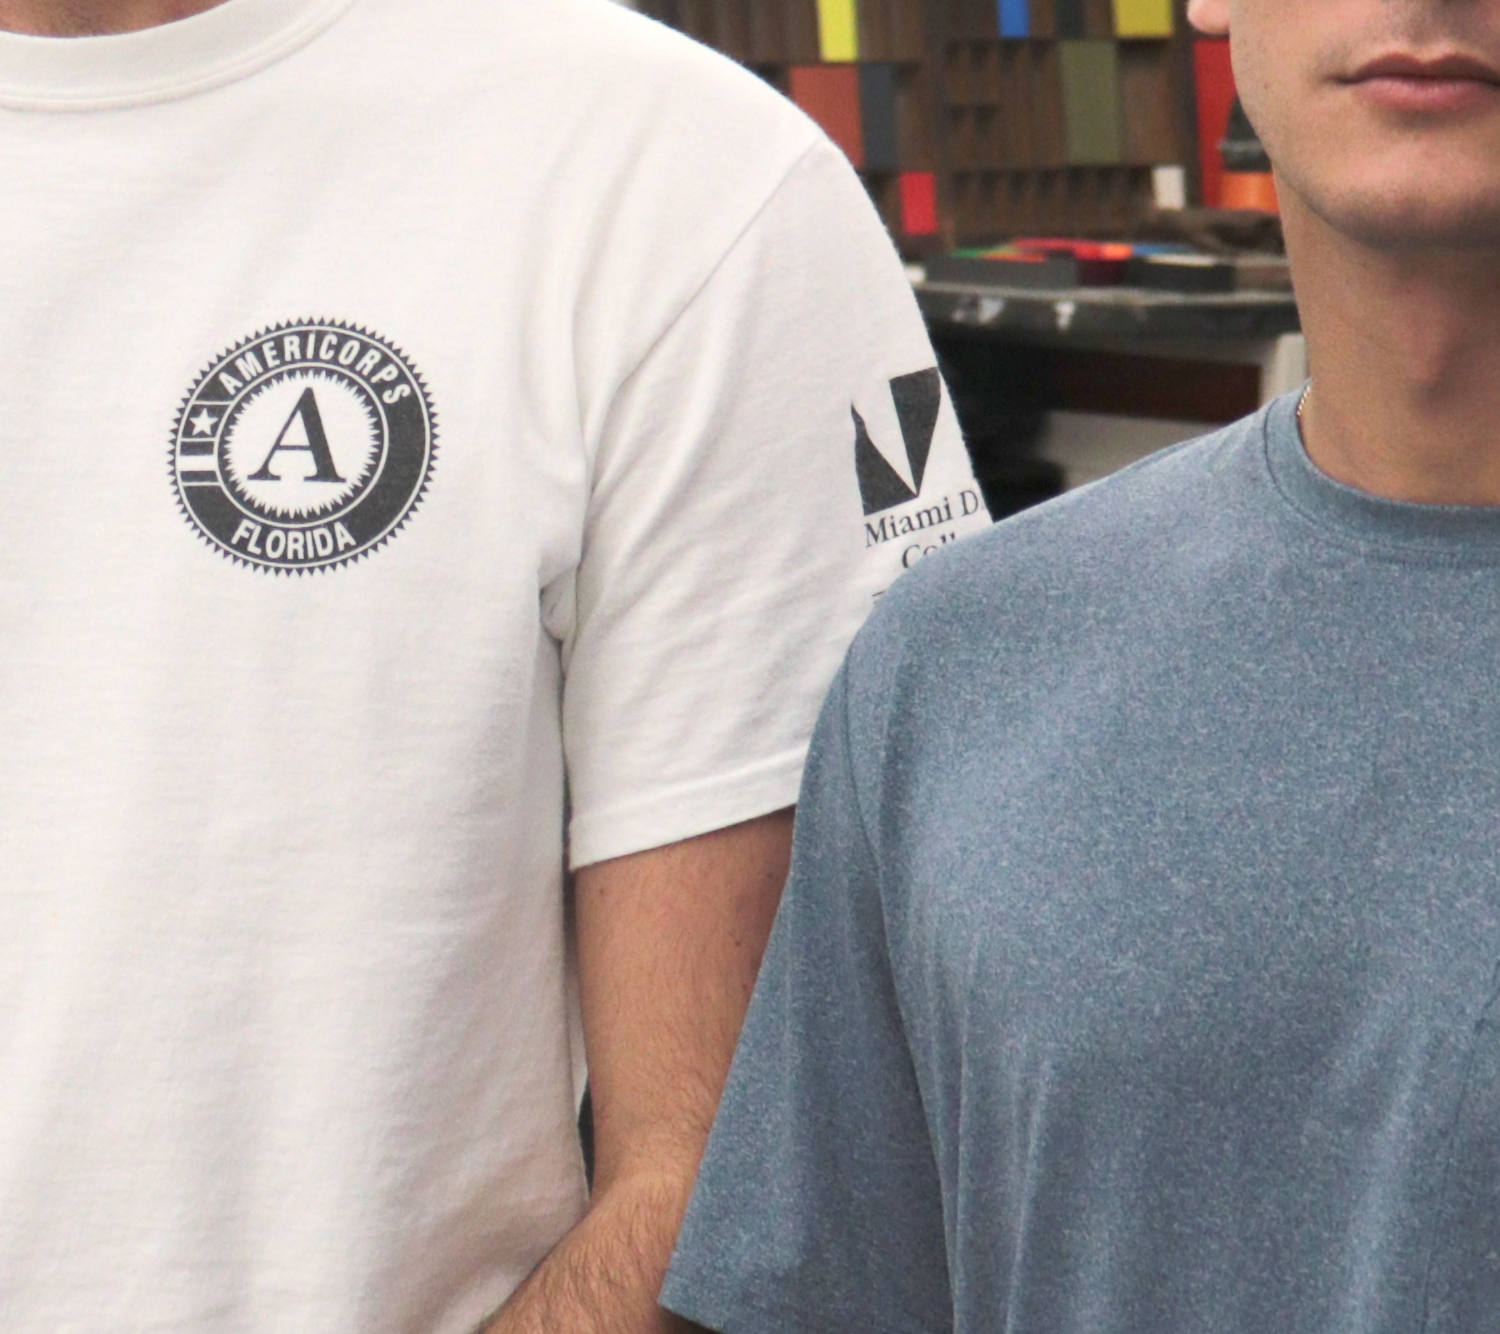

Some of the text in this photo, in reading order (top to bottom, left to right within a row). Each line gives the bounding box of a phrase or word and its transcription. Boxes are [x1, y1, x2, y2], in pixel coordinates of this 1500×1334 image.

[217, 331, 411, 405] AMERICORPS
[246, 386, 347, 484] A
[231, 518, 357, 561] FLORIDA
[863, 489, 984, 548] Miami D
